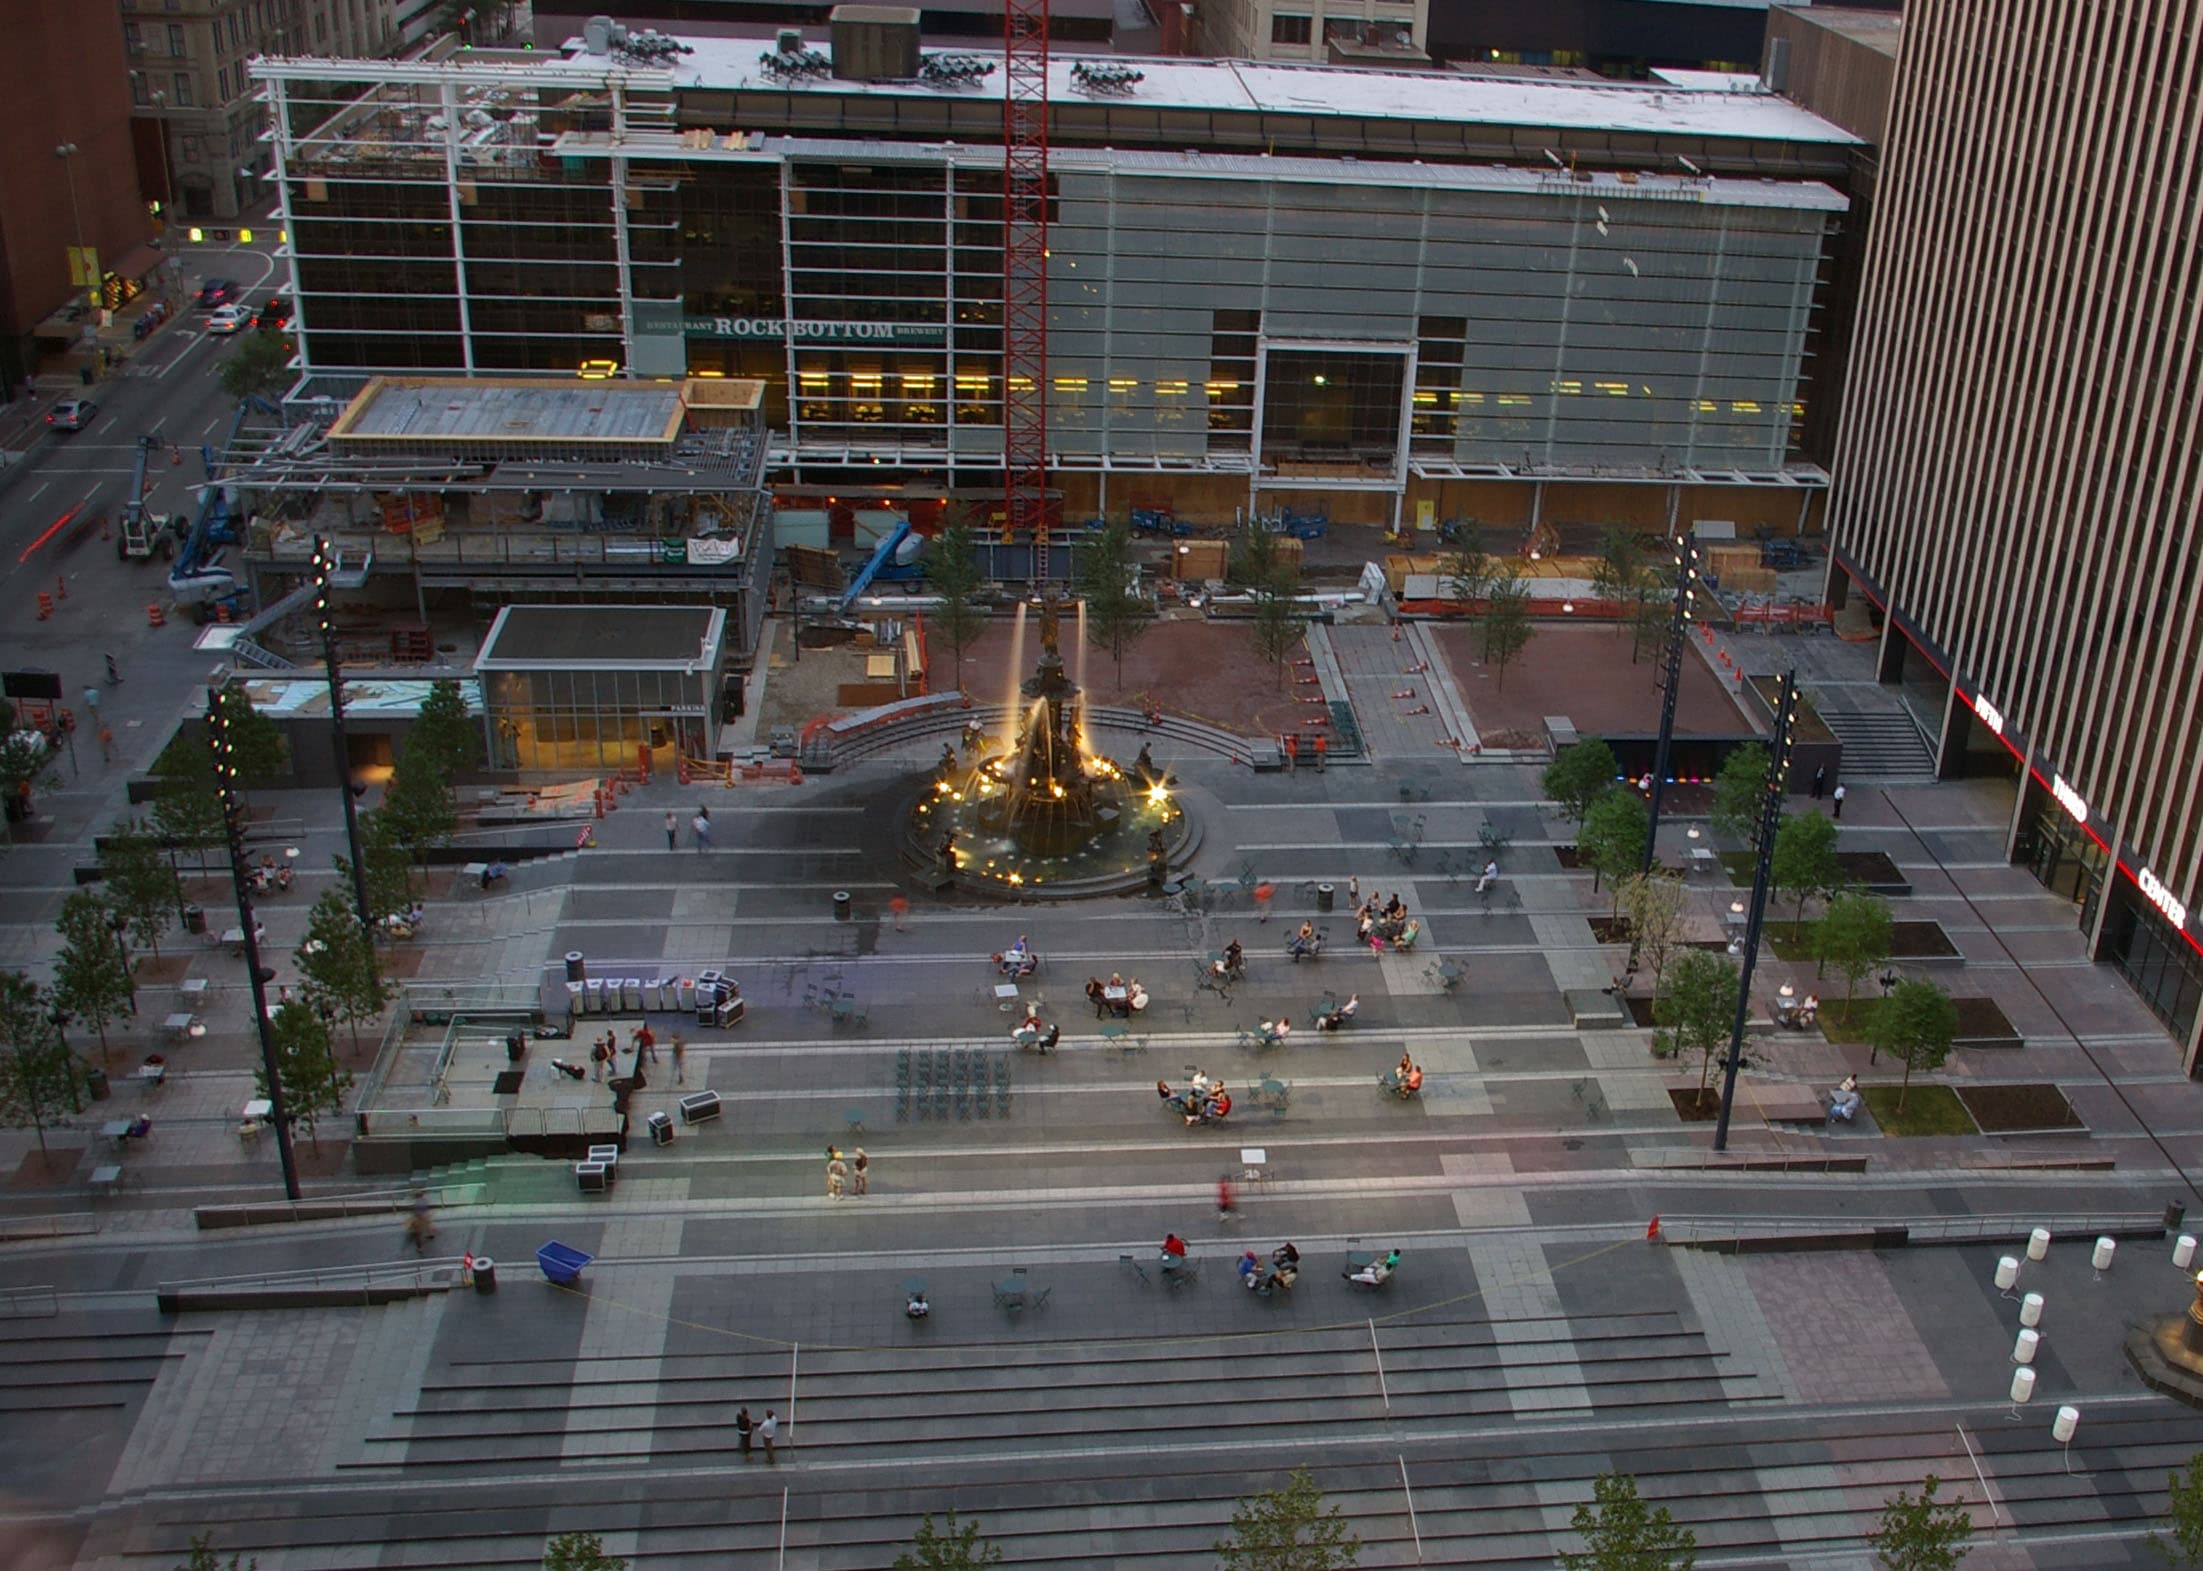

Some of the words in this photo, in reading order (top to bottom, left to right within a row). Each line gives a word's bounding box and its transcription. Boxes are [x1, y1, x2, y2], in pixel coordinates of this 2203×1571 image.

[646, 320, 714, 331] RESTAURANT
[714, 317, 785, 336] ROCK
[792, 319, 896, 339] BOTTOM
[896, 326, 945, 336] BREWERY
